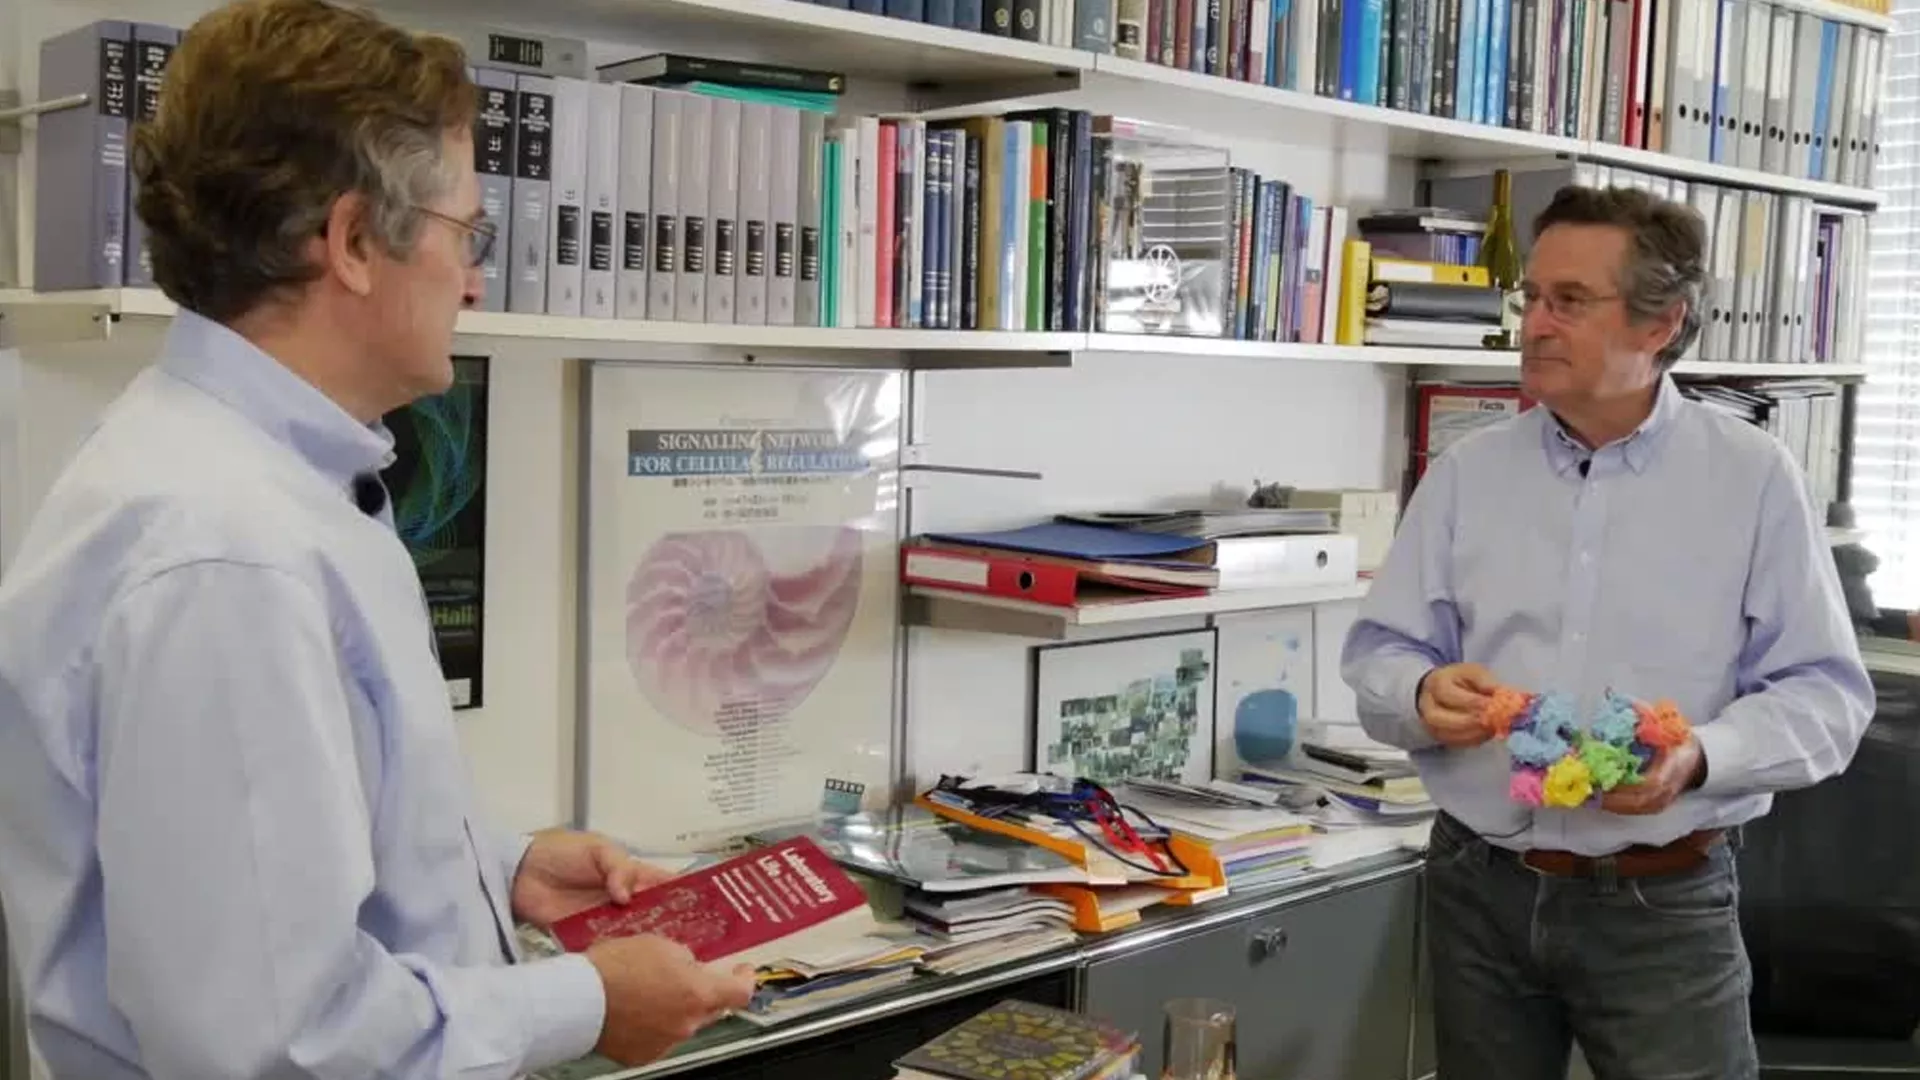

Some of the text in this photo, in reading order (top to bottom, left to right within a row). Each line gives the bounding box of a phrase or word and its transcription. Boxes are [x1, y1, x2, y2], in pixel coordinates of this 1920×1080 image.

[633, 454, 673, 473] FOR
[675, 453, 756, 472] CELLULA
[756, 855, 783, 880] Life
[780, 846, 838, 904] Laboratory
